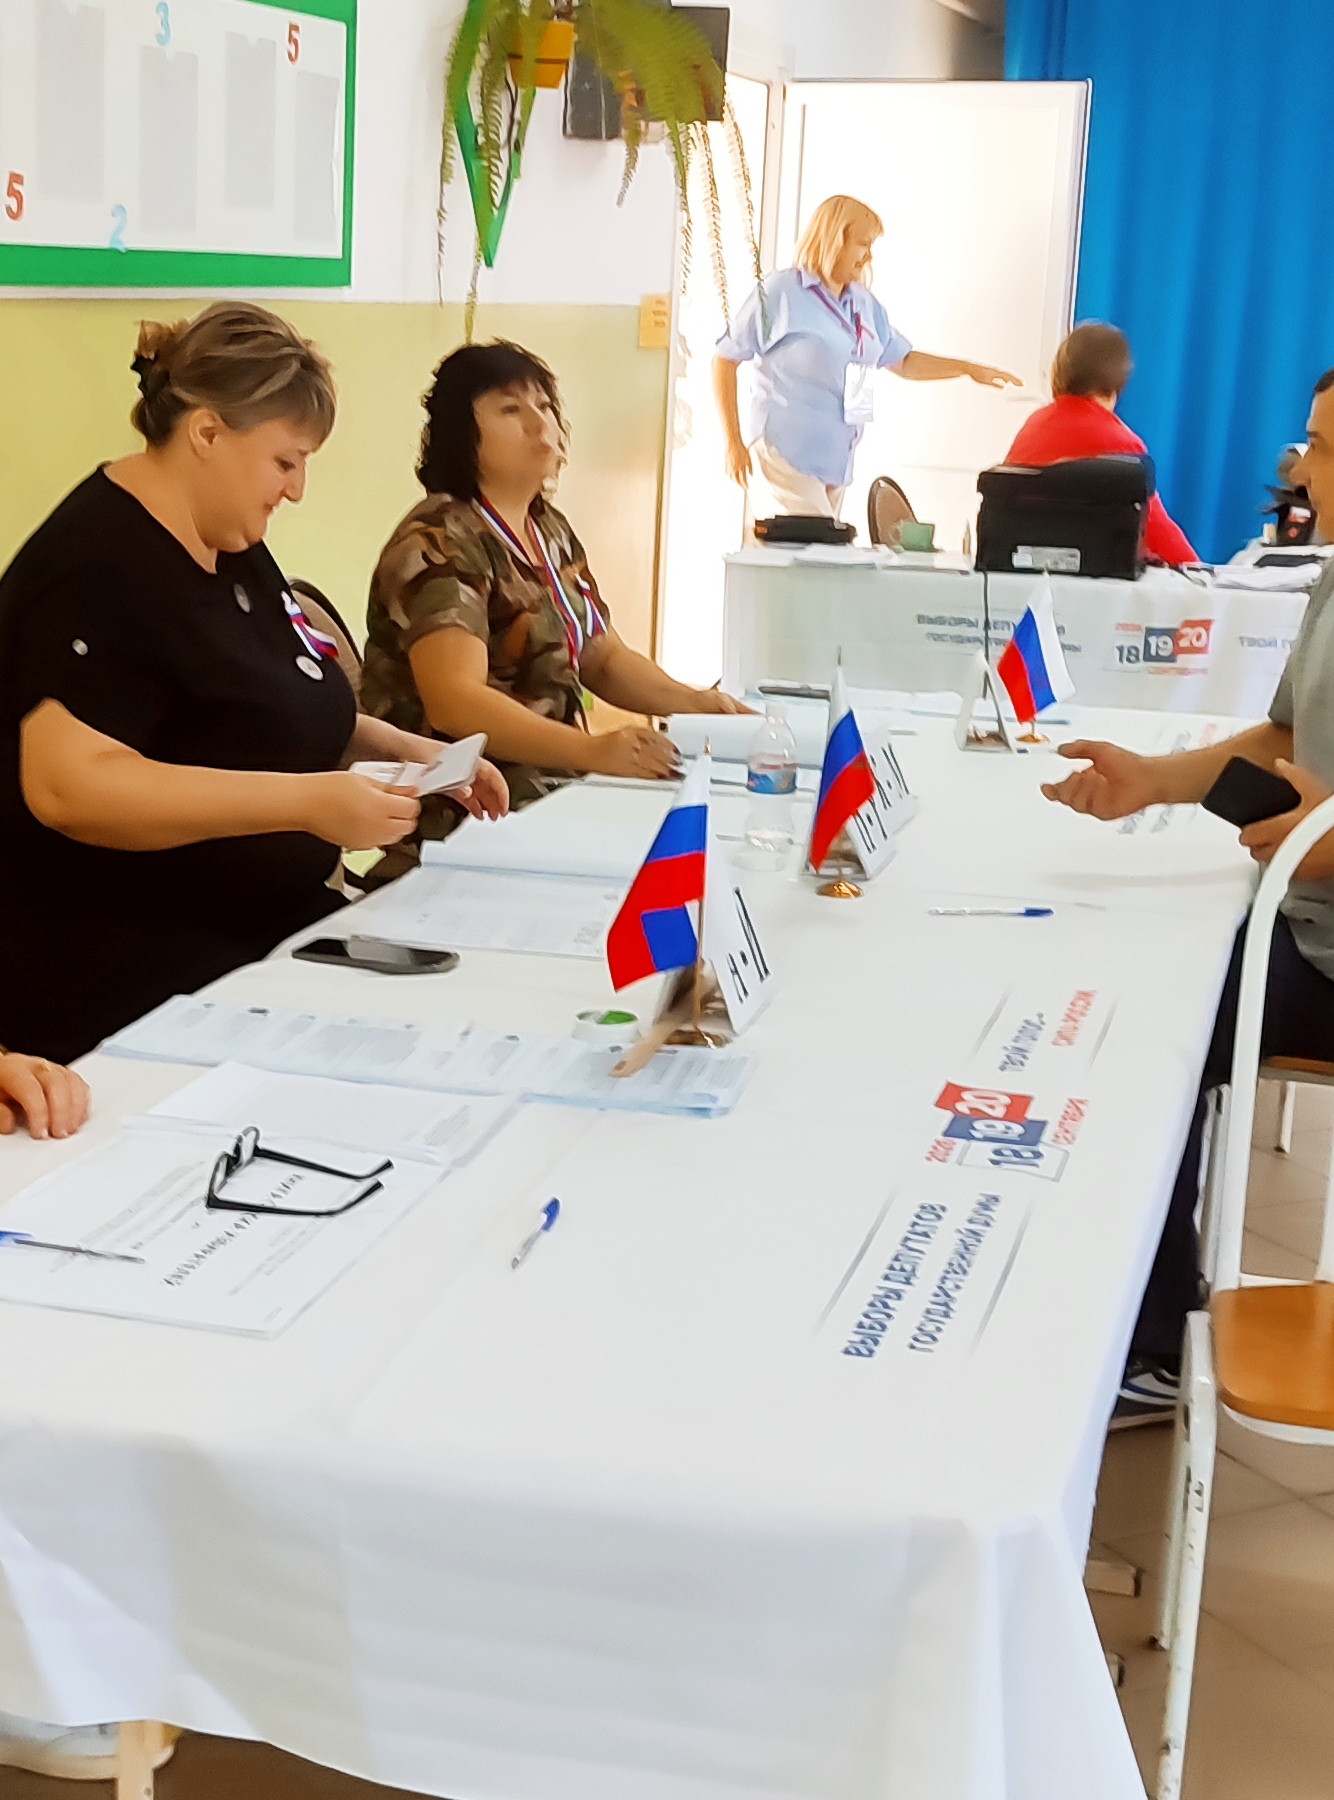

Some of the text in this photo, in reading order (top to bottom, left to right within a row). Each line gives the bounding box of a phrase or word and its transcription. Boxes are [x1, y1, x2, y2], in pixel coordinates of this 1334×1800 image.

[155, 1, 172, 46] 3
[286, 23, 301, 63] 5
[5, 172, 25, 221] 5
[108, 204, 129, 253] 2
[1116, 626, 1208, 664] 18 19 20
[955, 1089, 1045, 1169] 18 19 20
[840, 1202, 949, 1359] ВЫБОРЫ ДЕПУТАТОВ
